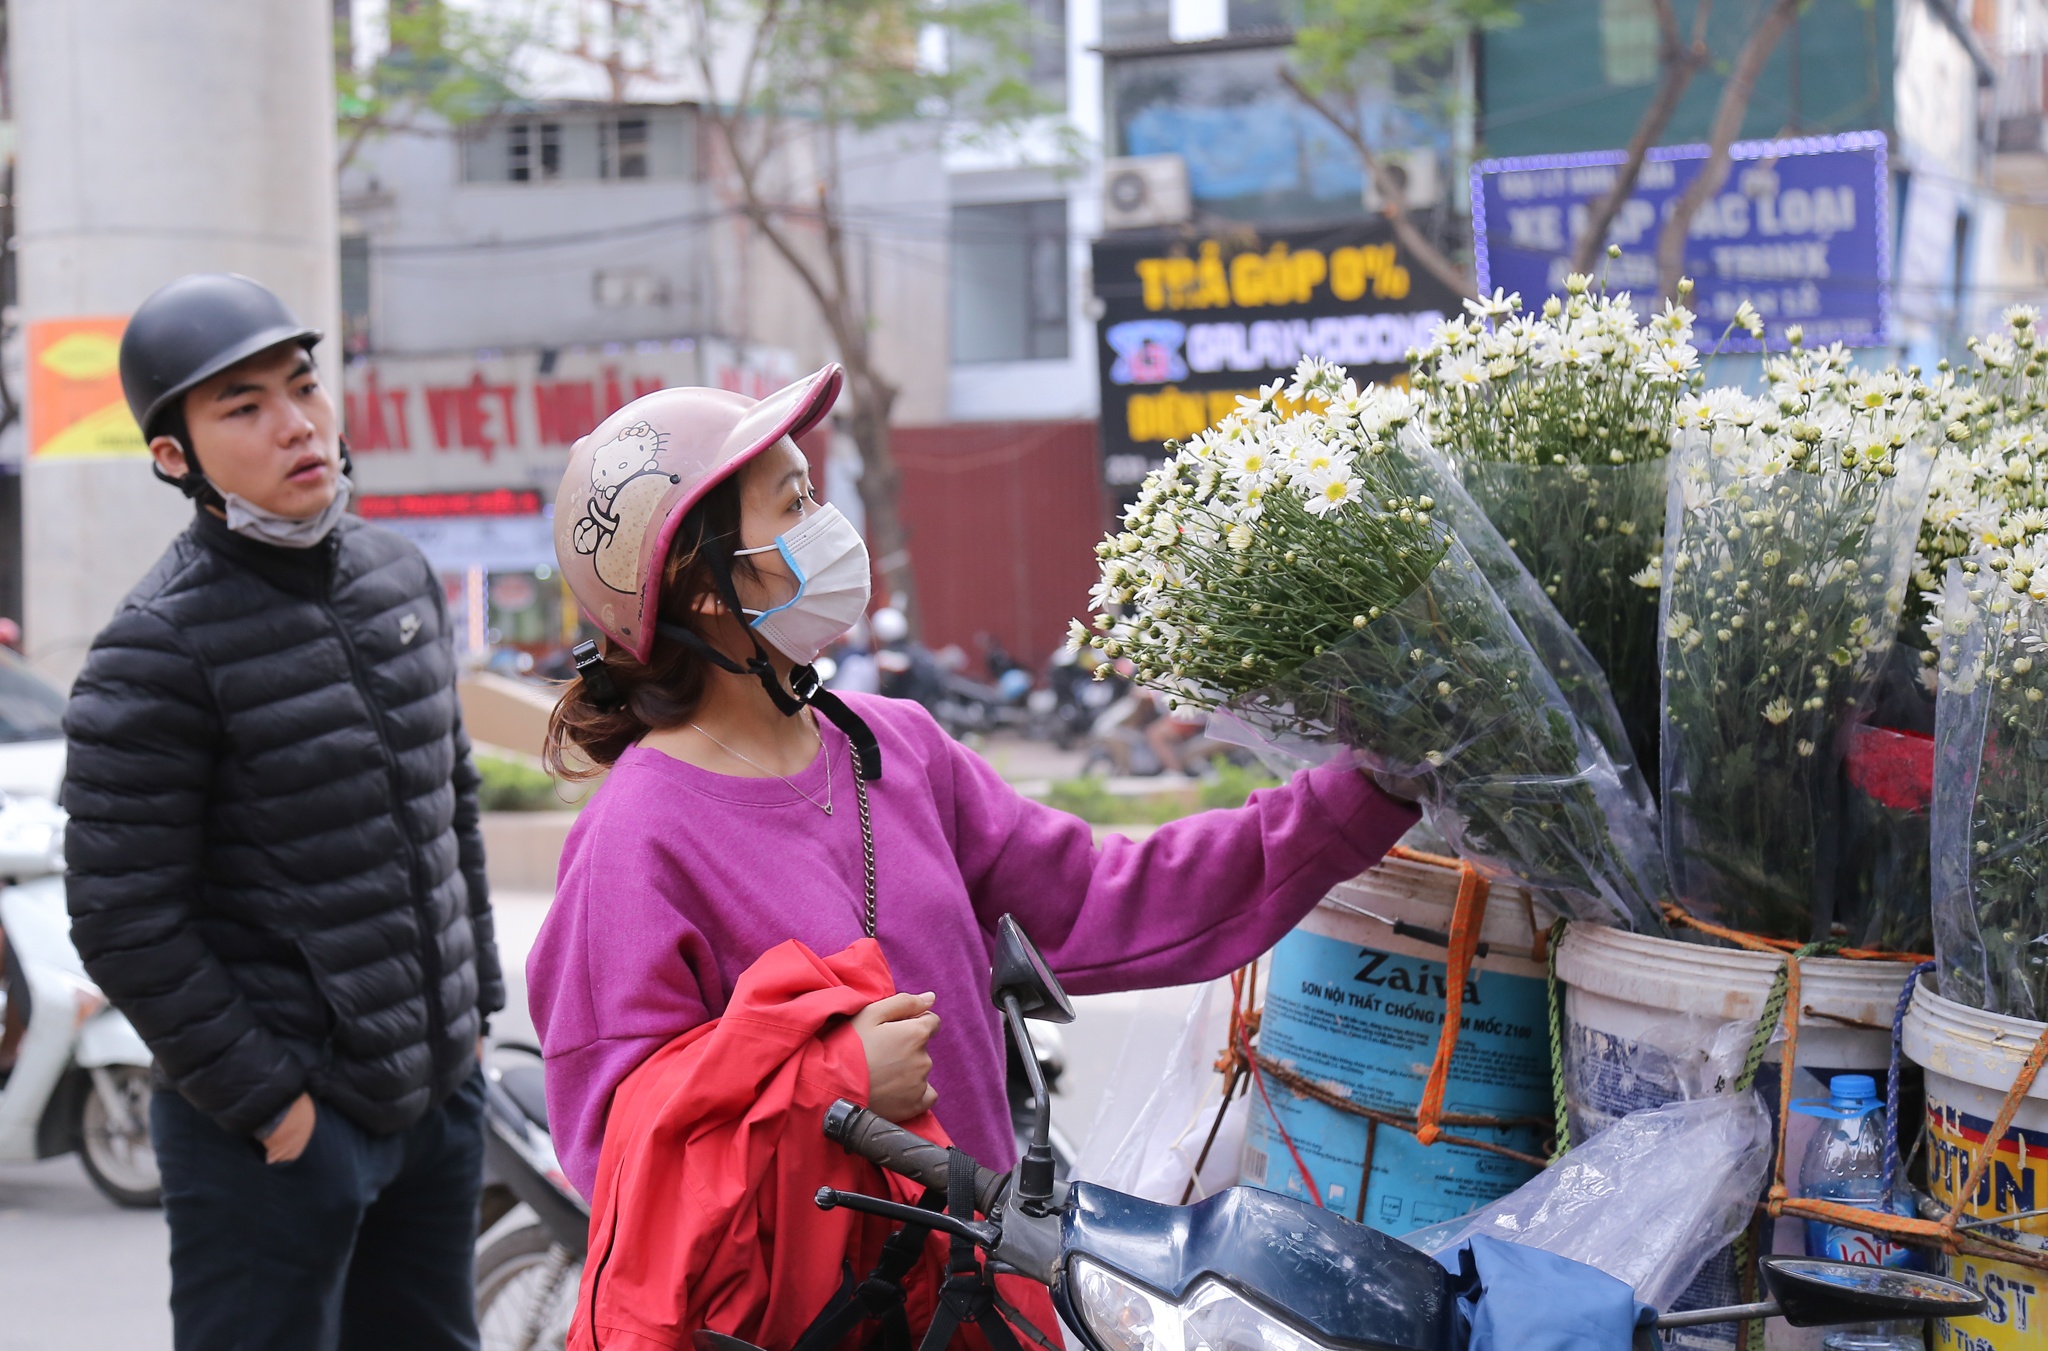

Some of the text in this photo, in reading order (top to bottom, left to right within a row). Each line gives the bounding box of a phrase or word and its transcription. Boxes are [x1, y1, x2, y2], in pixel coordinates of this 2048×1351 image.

[1329, 243, 1411, 301] 0%
[1324, 985, 1345, 1006] NỘI
[1349, 992, 1382, 1012] THẤT
[1385, 1001, 1435, 1024] CHỐNG
[1473, 1016, 1503, 1035] MỐC
